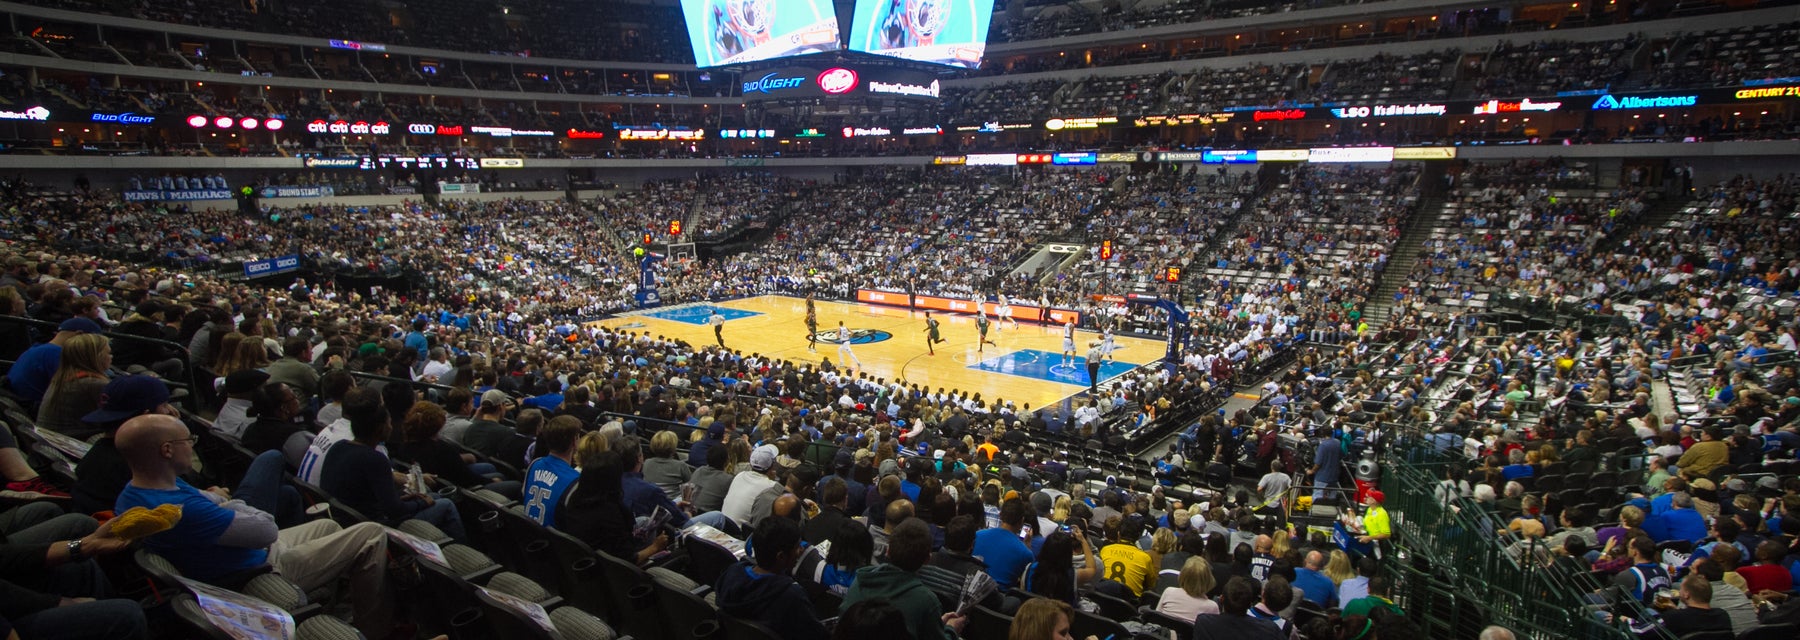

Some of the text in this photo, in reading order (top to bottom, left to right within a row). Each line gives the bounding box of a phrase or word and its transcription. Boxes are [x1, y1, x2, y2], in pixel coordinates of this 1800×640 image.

[743, 82, 759, 93] BUD
[763, 77, 805, 89] LIGHT
[1735, 87, 1786, 99] CENTURY
[1618, 95, 1697, 109] Albertsons
[92, 113, 155, 123] BUD LIGHT
[307, 121, 328, 133] citi
[329, 121, 349, 134] citi
[350, 121, 370, 135] citi
[370, 122, 390, 135] citi
[436, 125, 463, 136] Audi
[312, 159, 333, 167] BUD
[333, 159, 358, 167] LIGHT
[124, 191, 159, 201] MAVS
[248, 262, 271, 273] GEICO
[276, 258, 297, 268] GEICO
[524, 484, 553, 526] 25
[1110, 549, 1135, 561] YANNIS
[1110, 561, 1126, 585] 8
